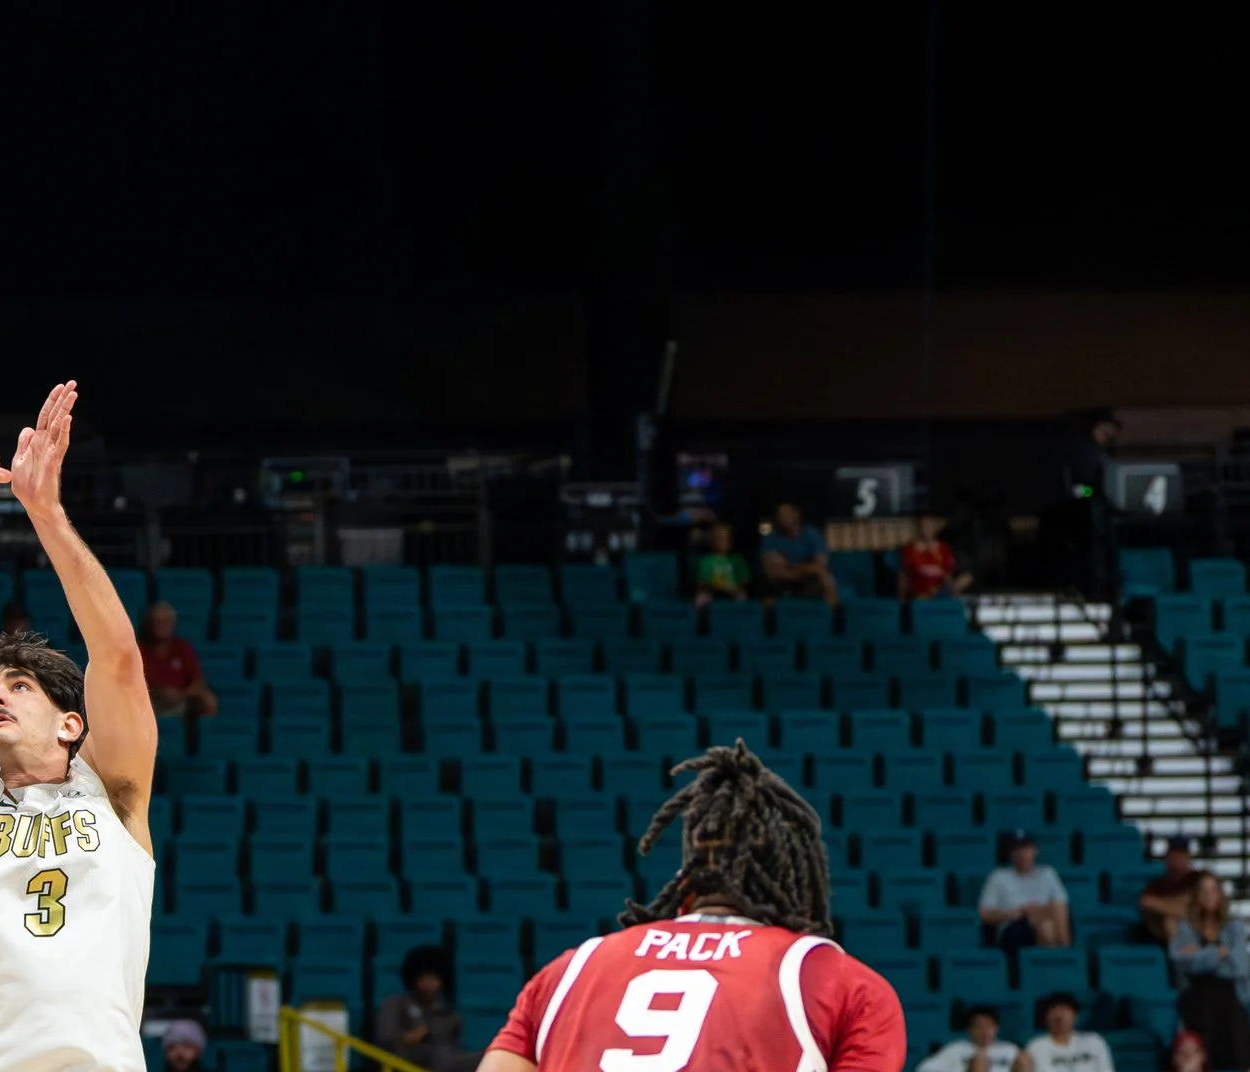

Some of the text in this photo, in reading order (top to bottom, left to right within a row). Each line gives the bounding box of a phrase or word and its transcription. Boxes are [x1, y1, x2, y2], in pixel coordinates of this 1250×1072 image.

[854, 478, 877, 516] 5
[24, 868, 69, 937] 3
[635, 928, 752, 961] PACK
